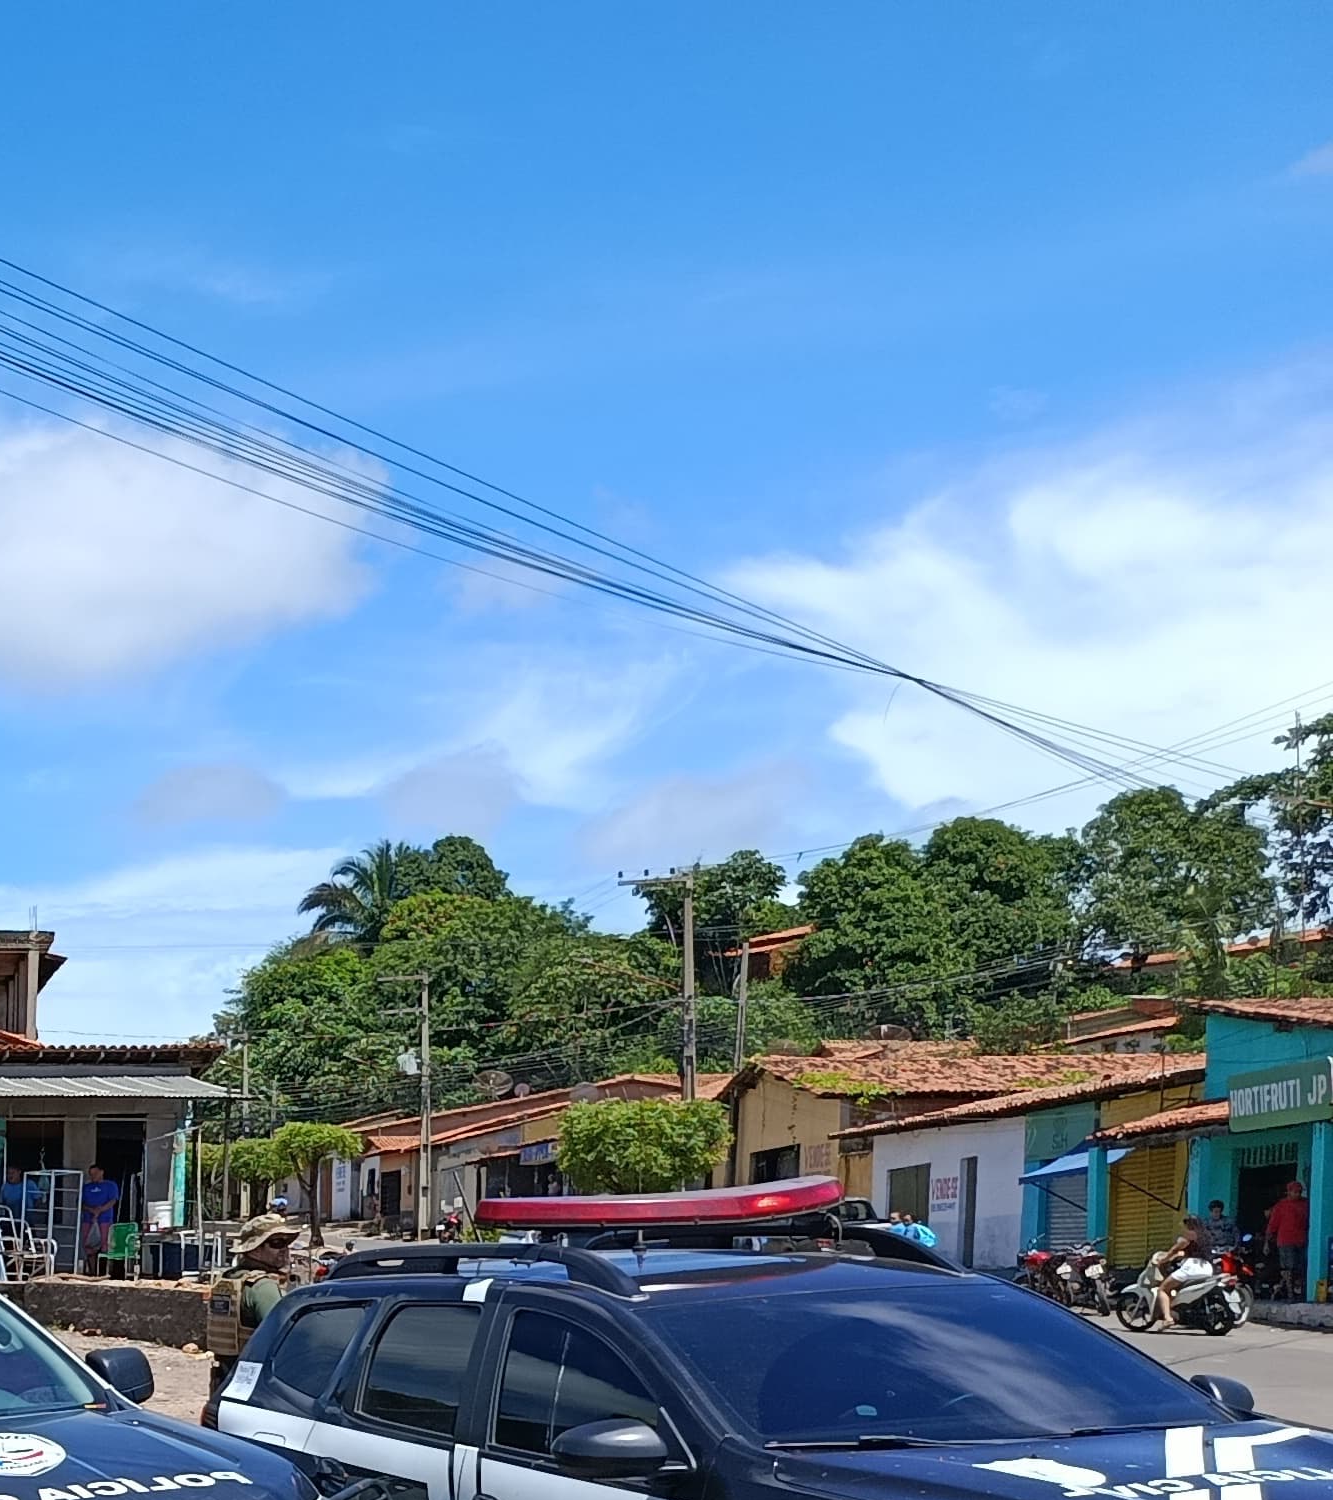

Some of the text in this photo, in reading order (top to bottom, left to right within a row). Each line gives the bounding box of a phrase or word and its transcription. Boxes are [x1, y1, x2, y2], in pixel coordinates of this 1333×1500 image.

[1229, 1074, 1327, 1118] HORTIFRUTI JP
[931, 1176, 959, 1200] VENDE-SE
